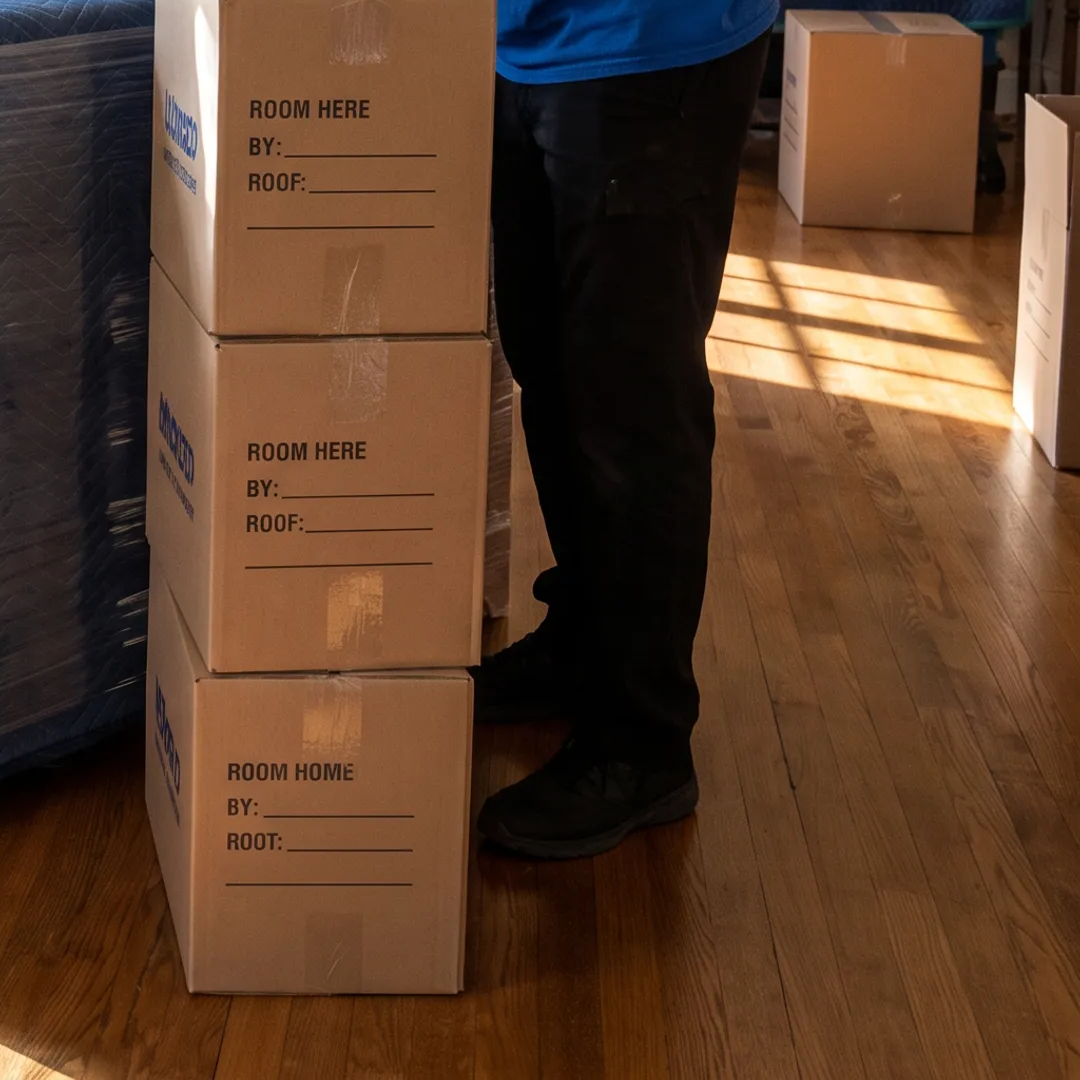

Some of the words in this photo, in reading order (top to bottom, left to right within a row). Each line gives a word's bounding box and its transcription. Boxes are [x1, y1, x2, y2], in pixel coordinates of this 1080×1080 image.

[249, 99, 310, 119] ROOM
[318, 99, 370, 119] HERE
[248, 137, 281, 156] BY:
[247, 172, 306, 192] ROOF:
[247, 442, 308, 461] ROOM
[315, 441, 367, 460] HERE
[246, 479, 279, 498] BY:
[246, 514, 304, 533] ROOF:
[227, 762, 288, 781] ROOM
[295, 762, 354, 781] HOME
[227, 798, 259, 816] BY:
[226, 832, 283, 851] ROOT:
